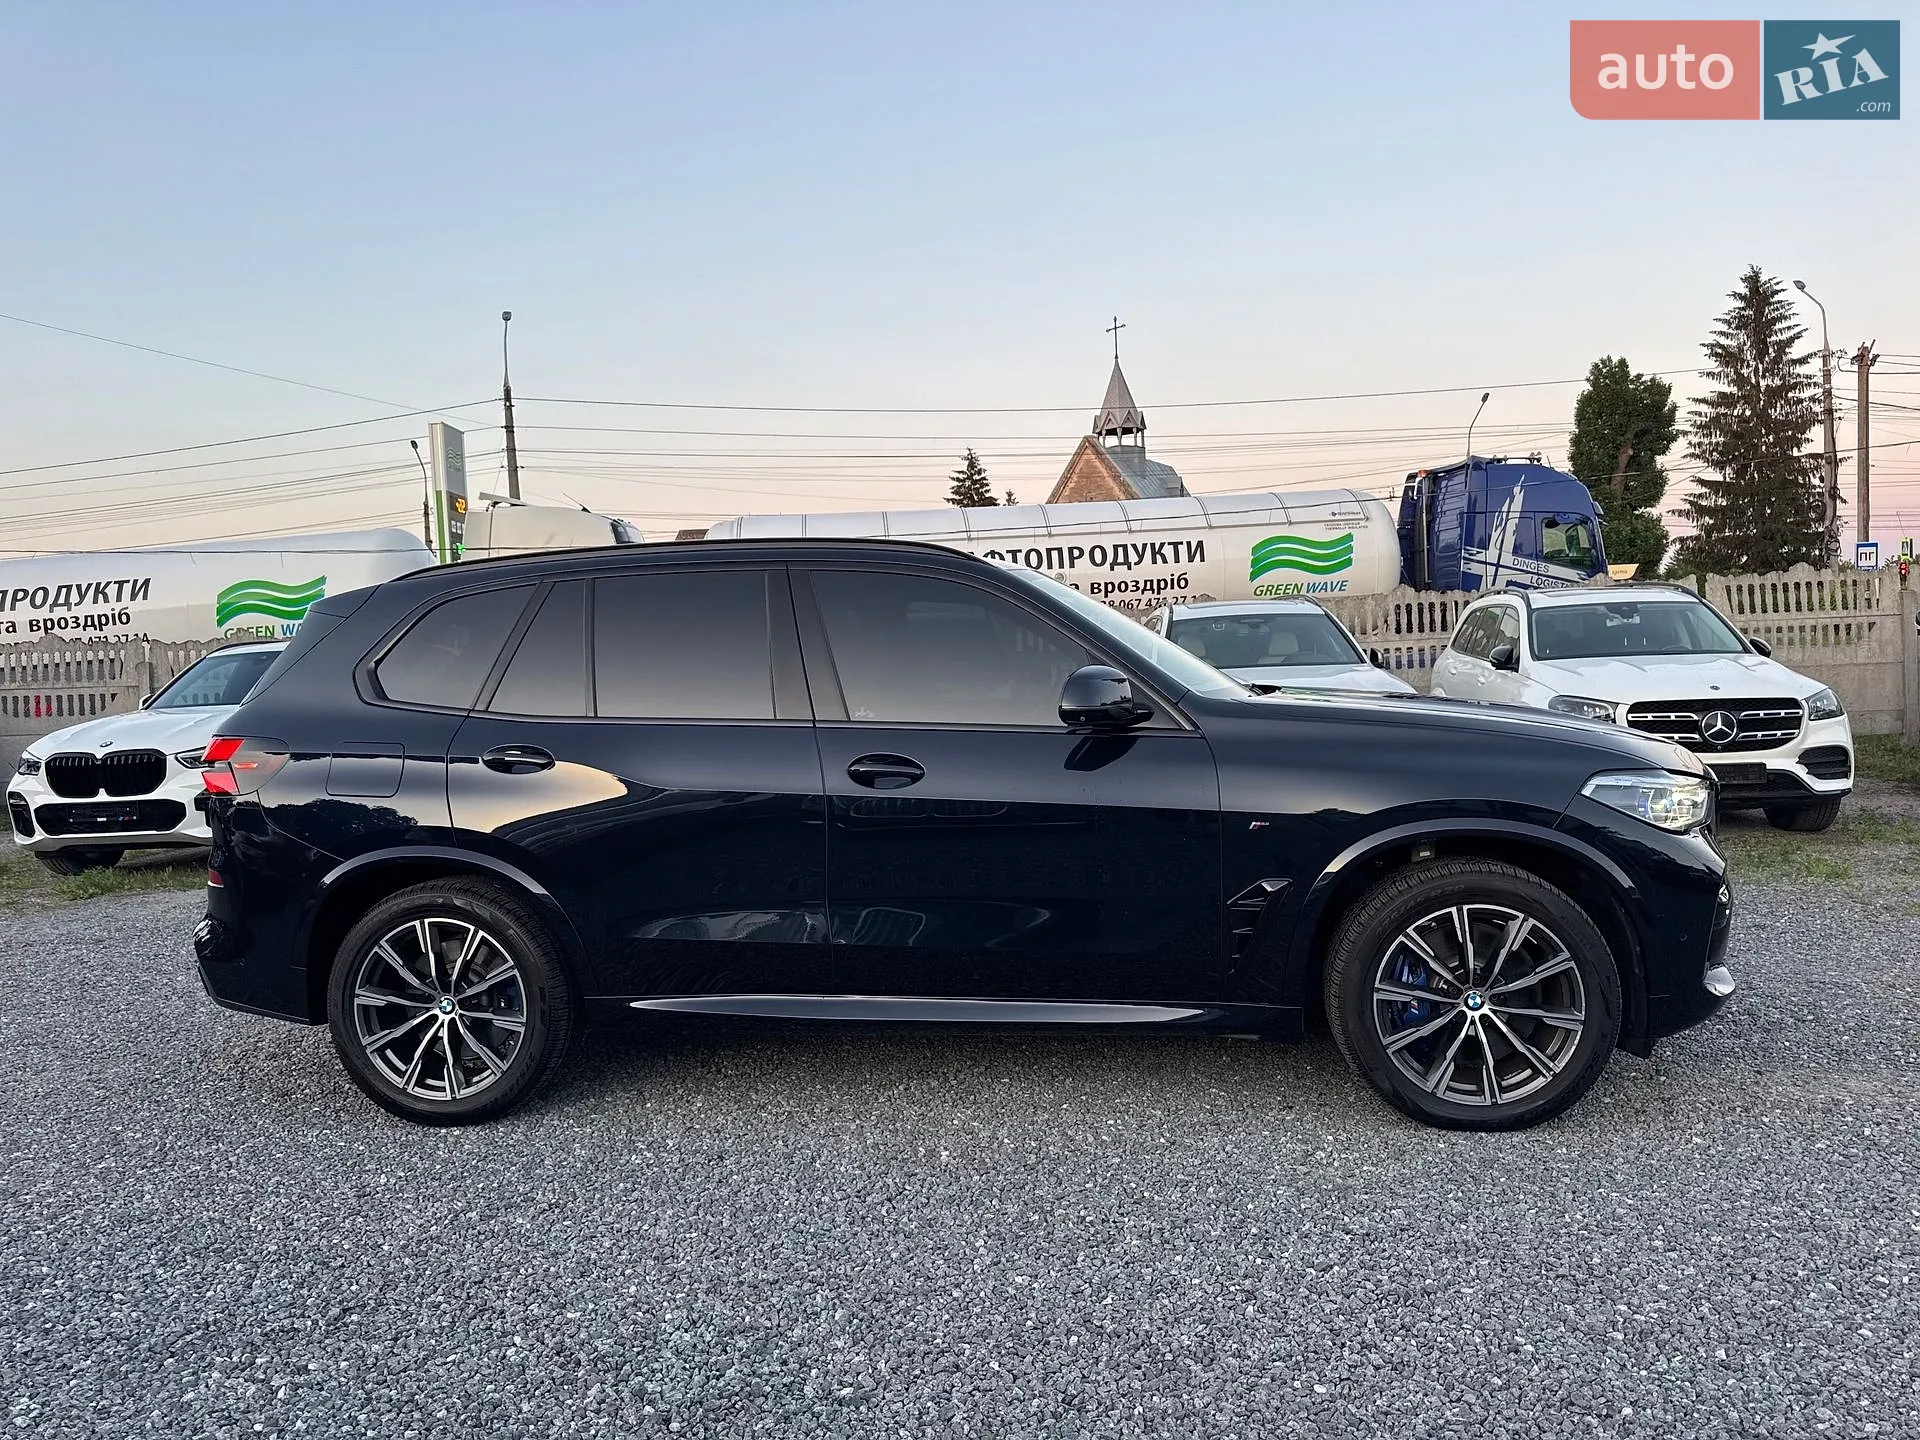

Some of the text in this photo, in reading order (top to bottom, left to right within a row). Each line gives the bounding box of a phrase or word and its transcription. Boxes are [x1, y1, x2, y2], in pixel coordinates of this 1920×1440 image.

[1512, 557, 1550, 574] DINGES
[1090, 572, 1189, 599] вроздріб
[1253, 579, 1349, 597] GREEN WAVE
[28, 606, 131, 635] вроздріб
